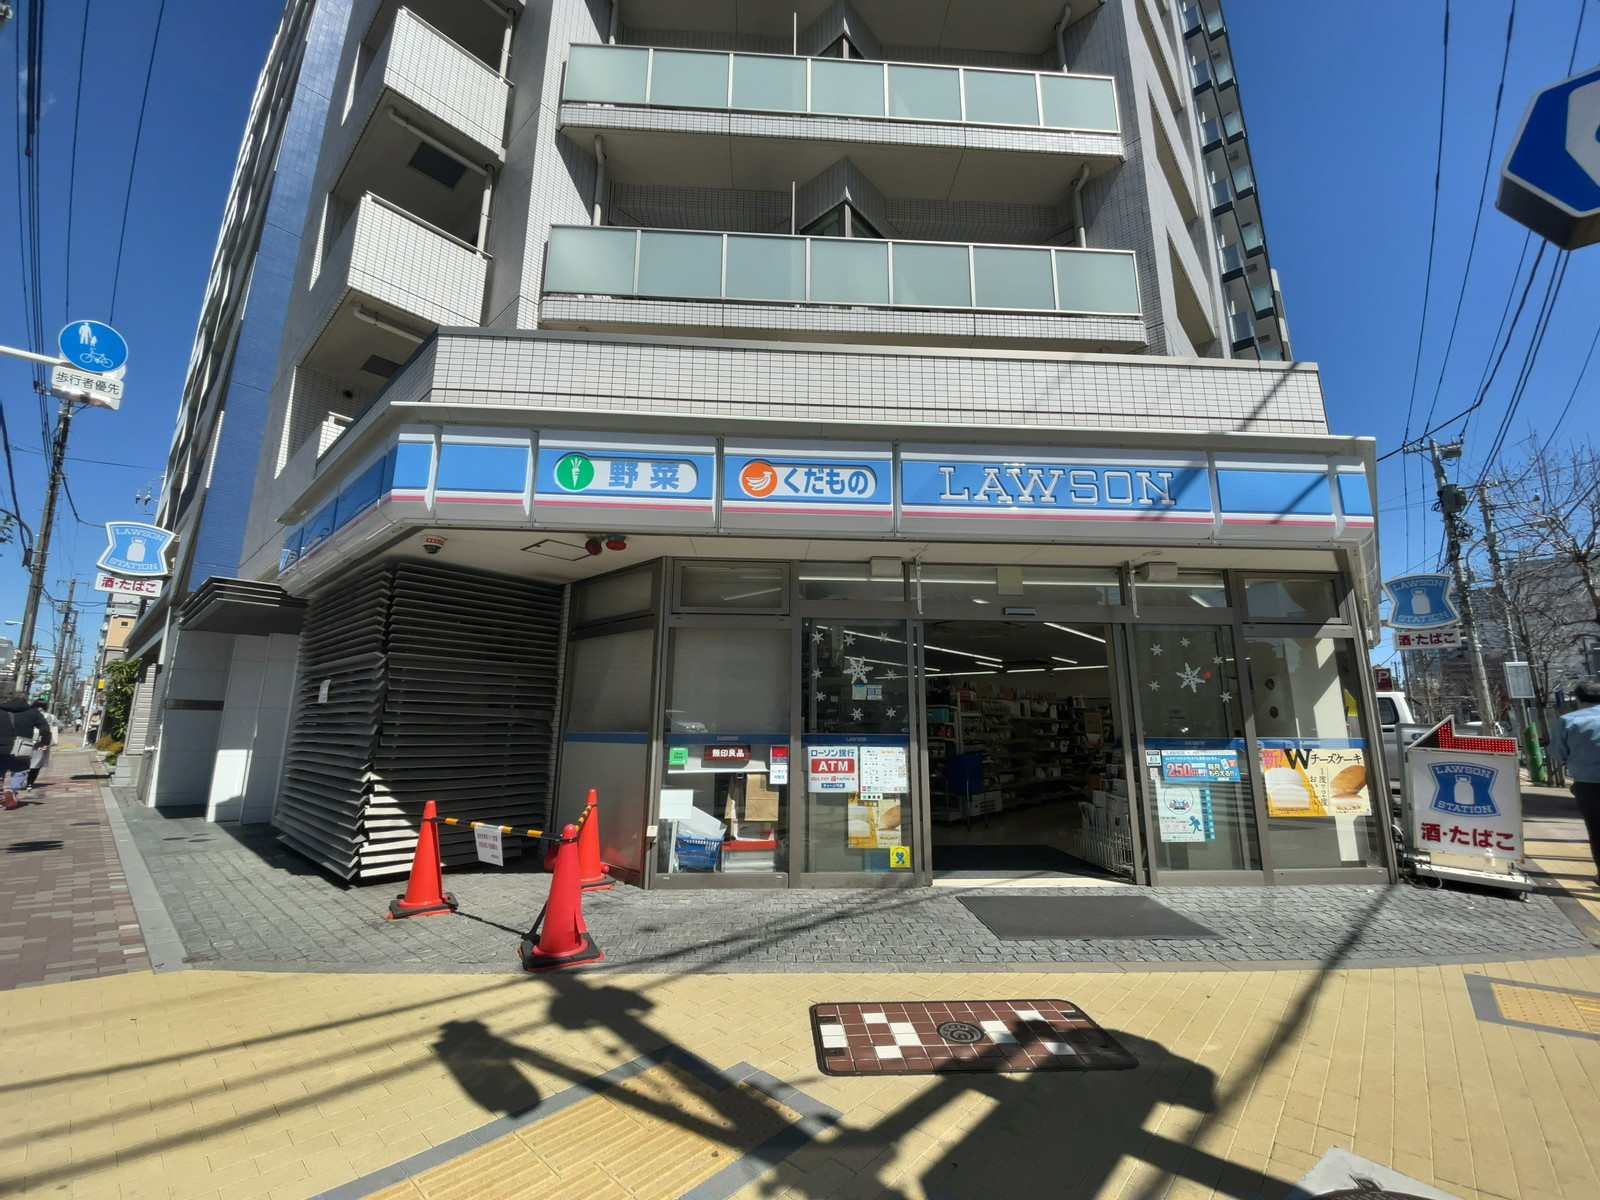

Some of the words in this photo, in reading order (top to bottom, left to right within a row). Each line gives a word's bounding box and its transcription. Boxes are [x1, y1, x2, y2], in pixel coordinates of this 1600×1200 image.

[56, 371, 119, 395] 歩行者優先
[608, 461, 679, 489] 野菜
[783, 468, 868, 495] くだもの
[939, 466, 1175, 505] LAWSON
[115, 528, 165, 541] LAWSON
[109, 558, 158, 570] STATION
[1392, 579, 1443, 592] LAWSON
[1397, 611, 1448, 624] STATION
[1398, 633, 1455, 646] 酒・たばこ
[1377, 671, 1389, 683] P
[712, 748, 745, 757] 無印良品
[810, 749, 855, 757] ローソン銀行
[1262, 749, 1284, 768] 新!
[818, 761, 849, 771] ATM
[1435, 766, 1491, 778] LAWSON
[1437, 801, 1492, 814] STATION
[1421, 822, 1515, 851] 酒・たばこ
